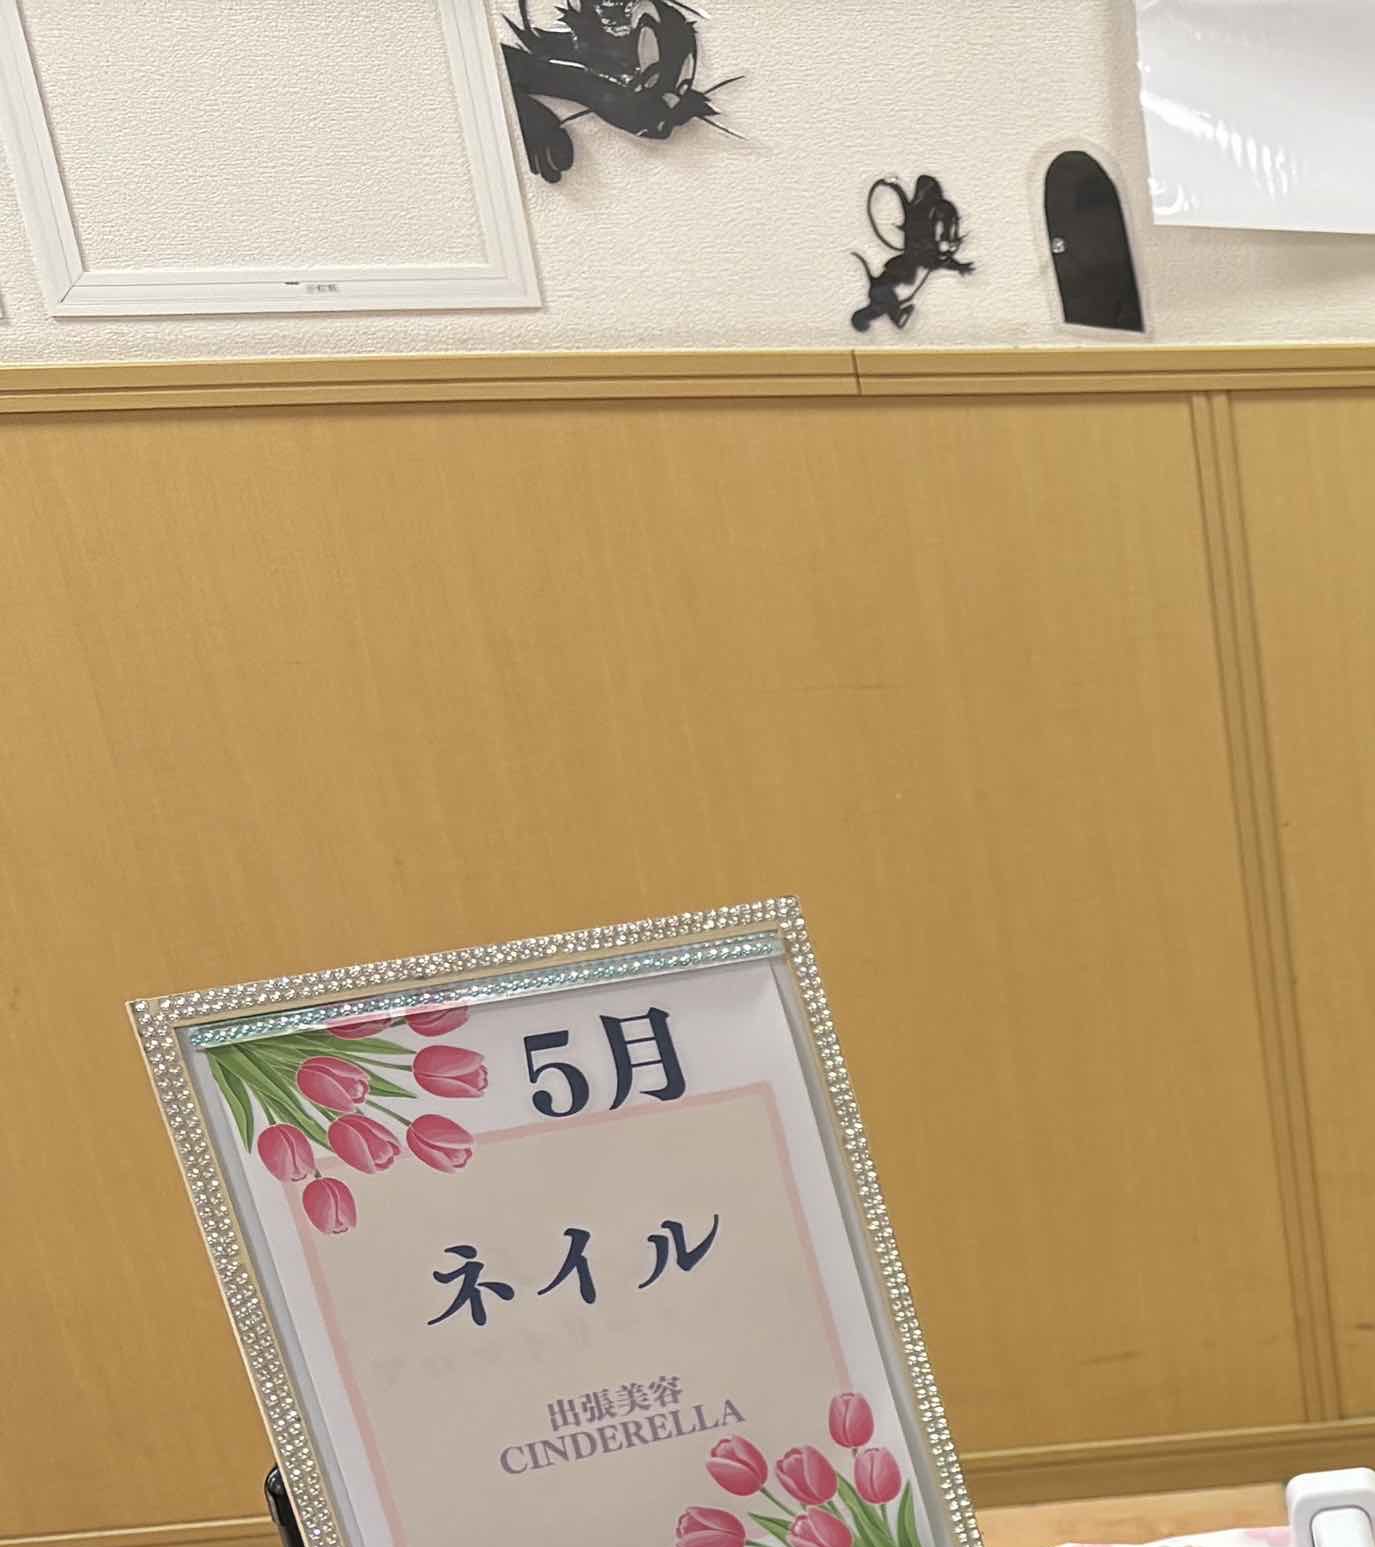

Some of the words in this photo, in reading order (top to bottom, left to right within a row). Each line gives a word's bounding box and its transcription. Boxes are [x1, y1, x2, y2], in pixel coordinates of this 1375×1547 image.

[523, 1007, 687, 1118] 5月
[427, 1213, 721, 1328] ネイル
[498, 1399, 747, 1477] CINDERELLA
[546, 1374, 684, 1434] 出張美容
